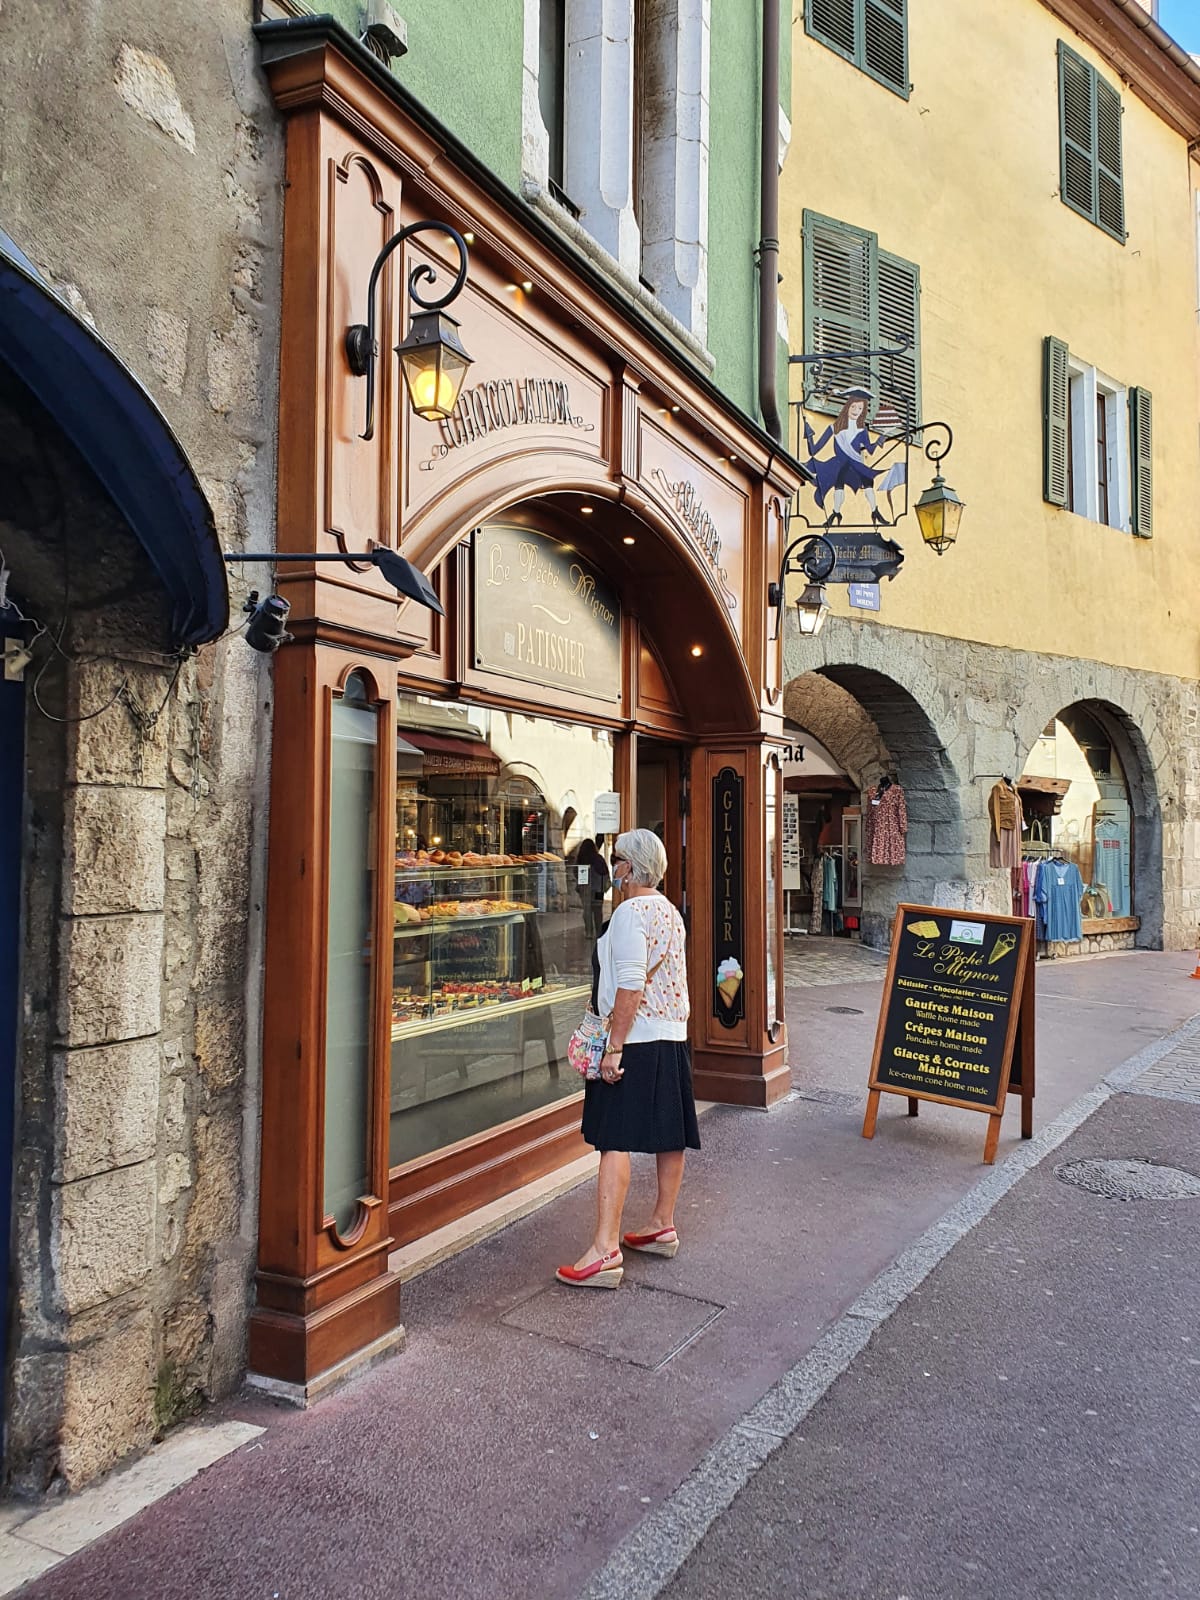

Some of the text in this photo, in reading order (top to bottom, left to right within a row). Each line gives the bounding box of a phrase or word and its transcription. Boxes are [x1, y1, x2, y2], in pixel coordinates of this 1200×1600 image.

[487, 541, 615, 627] Le Péché Mignon
[517, 622, 586, 679] PATISSIER
[723, 790, 733, 942] GLACIER
[913, 941, 985, 966] Le Péché
[933, 960, 1000, 984] Mignon
[933, 985, 975, 997] Chocolatier
[980, 992, 1008, 1003] Glacier
[905, 997, 994, 1021] Gaufres Maison
[915, 1010, 980, 1028] Waffle home made
[905, 1021, 988, 1045] Crêpes Maison
[905, 1033, 983, 1055] Pancakes home made
[893, 1047, 990, 1074] Glaces & Cornets
[918, 1062, 960, 1079] Maison
[889, 1068, 989, 1095] Ice-cream cone home made
